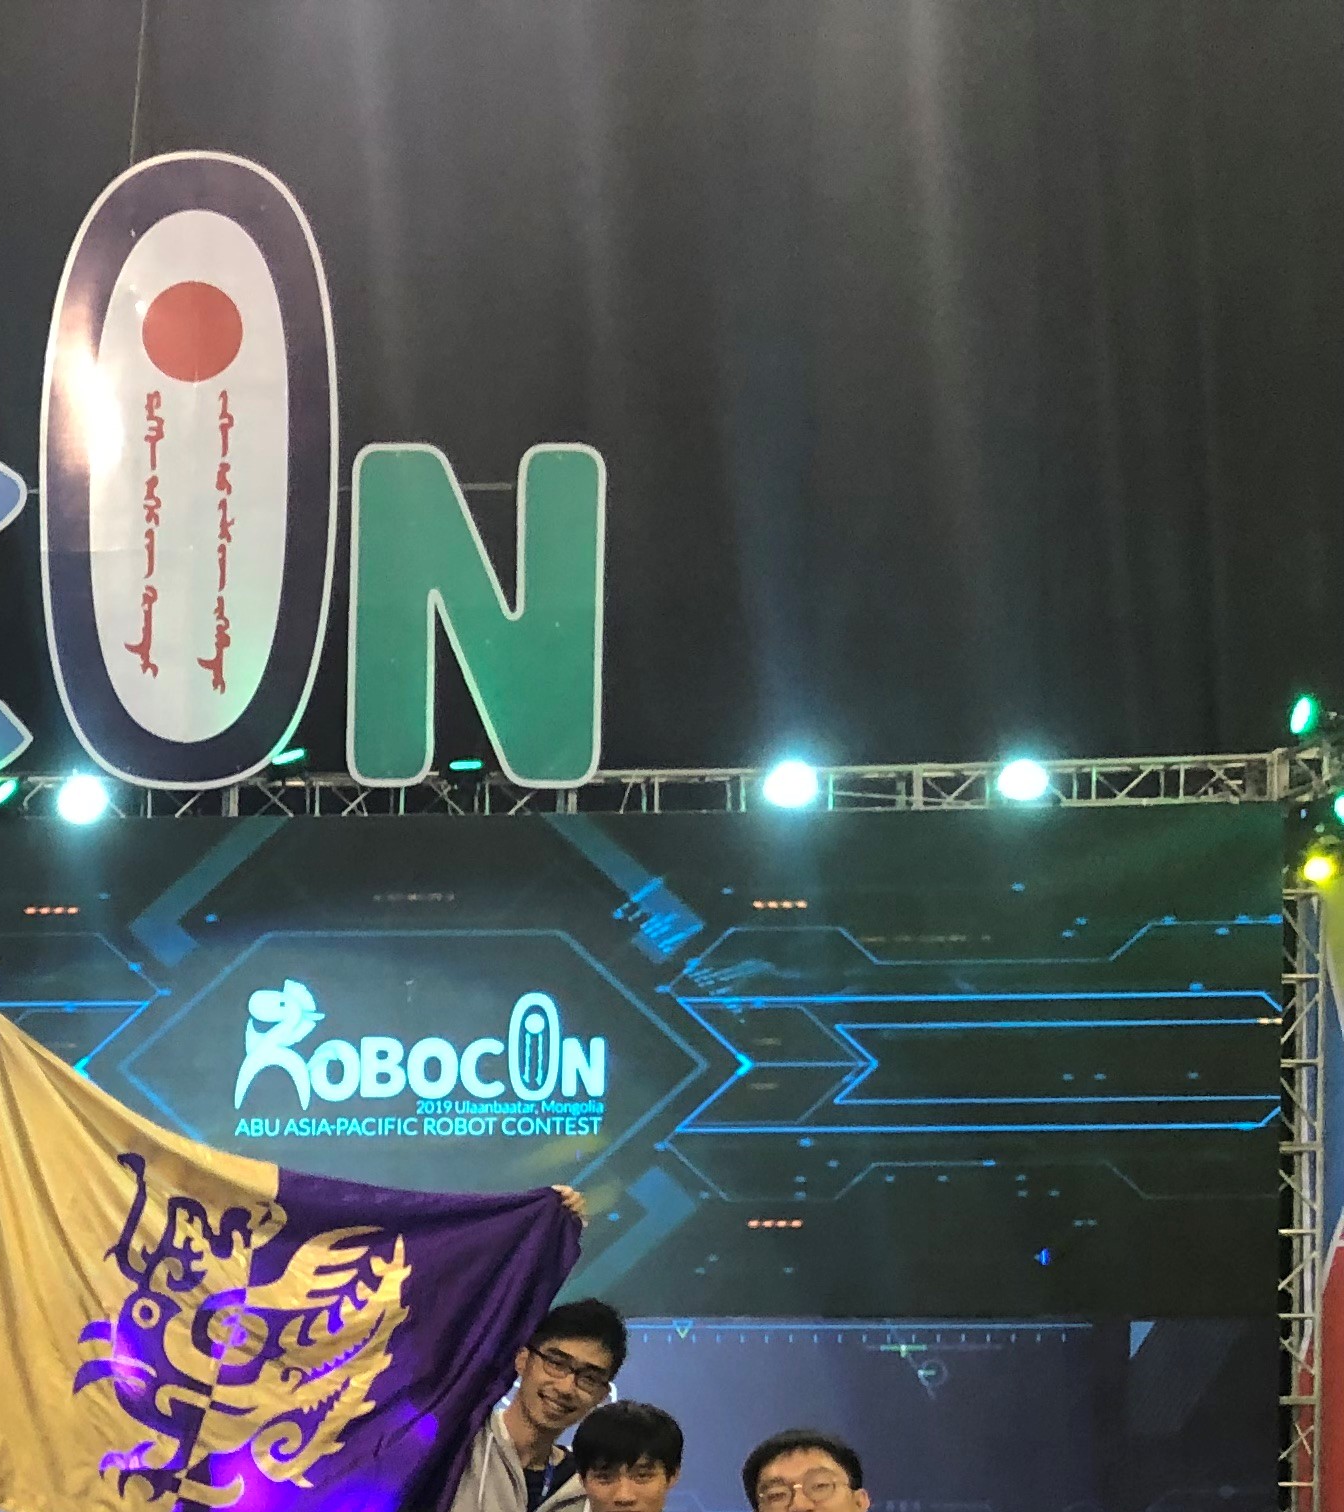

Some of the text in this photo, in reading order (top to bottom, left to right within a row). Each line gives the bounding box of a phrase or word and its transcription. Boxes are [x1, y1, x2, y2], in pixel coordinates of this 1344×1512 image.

[416, 1100, 605, 1116] 2019 Ulaanbaatar, Mongolia
[234, 1117, 603, 1137] ABU ASIA-PACIFIC ROBOT CONTEST
